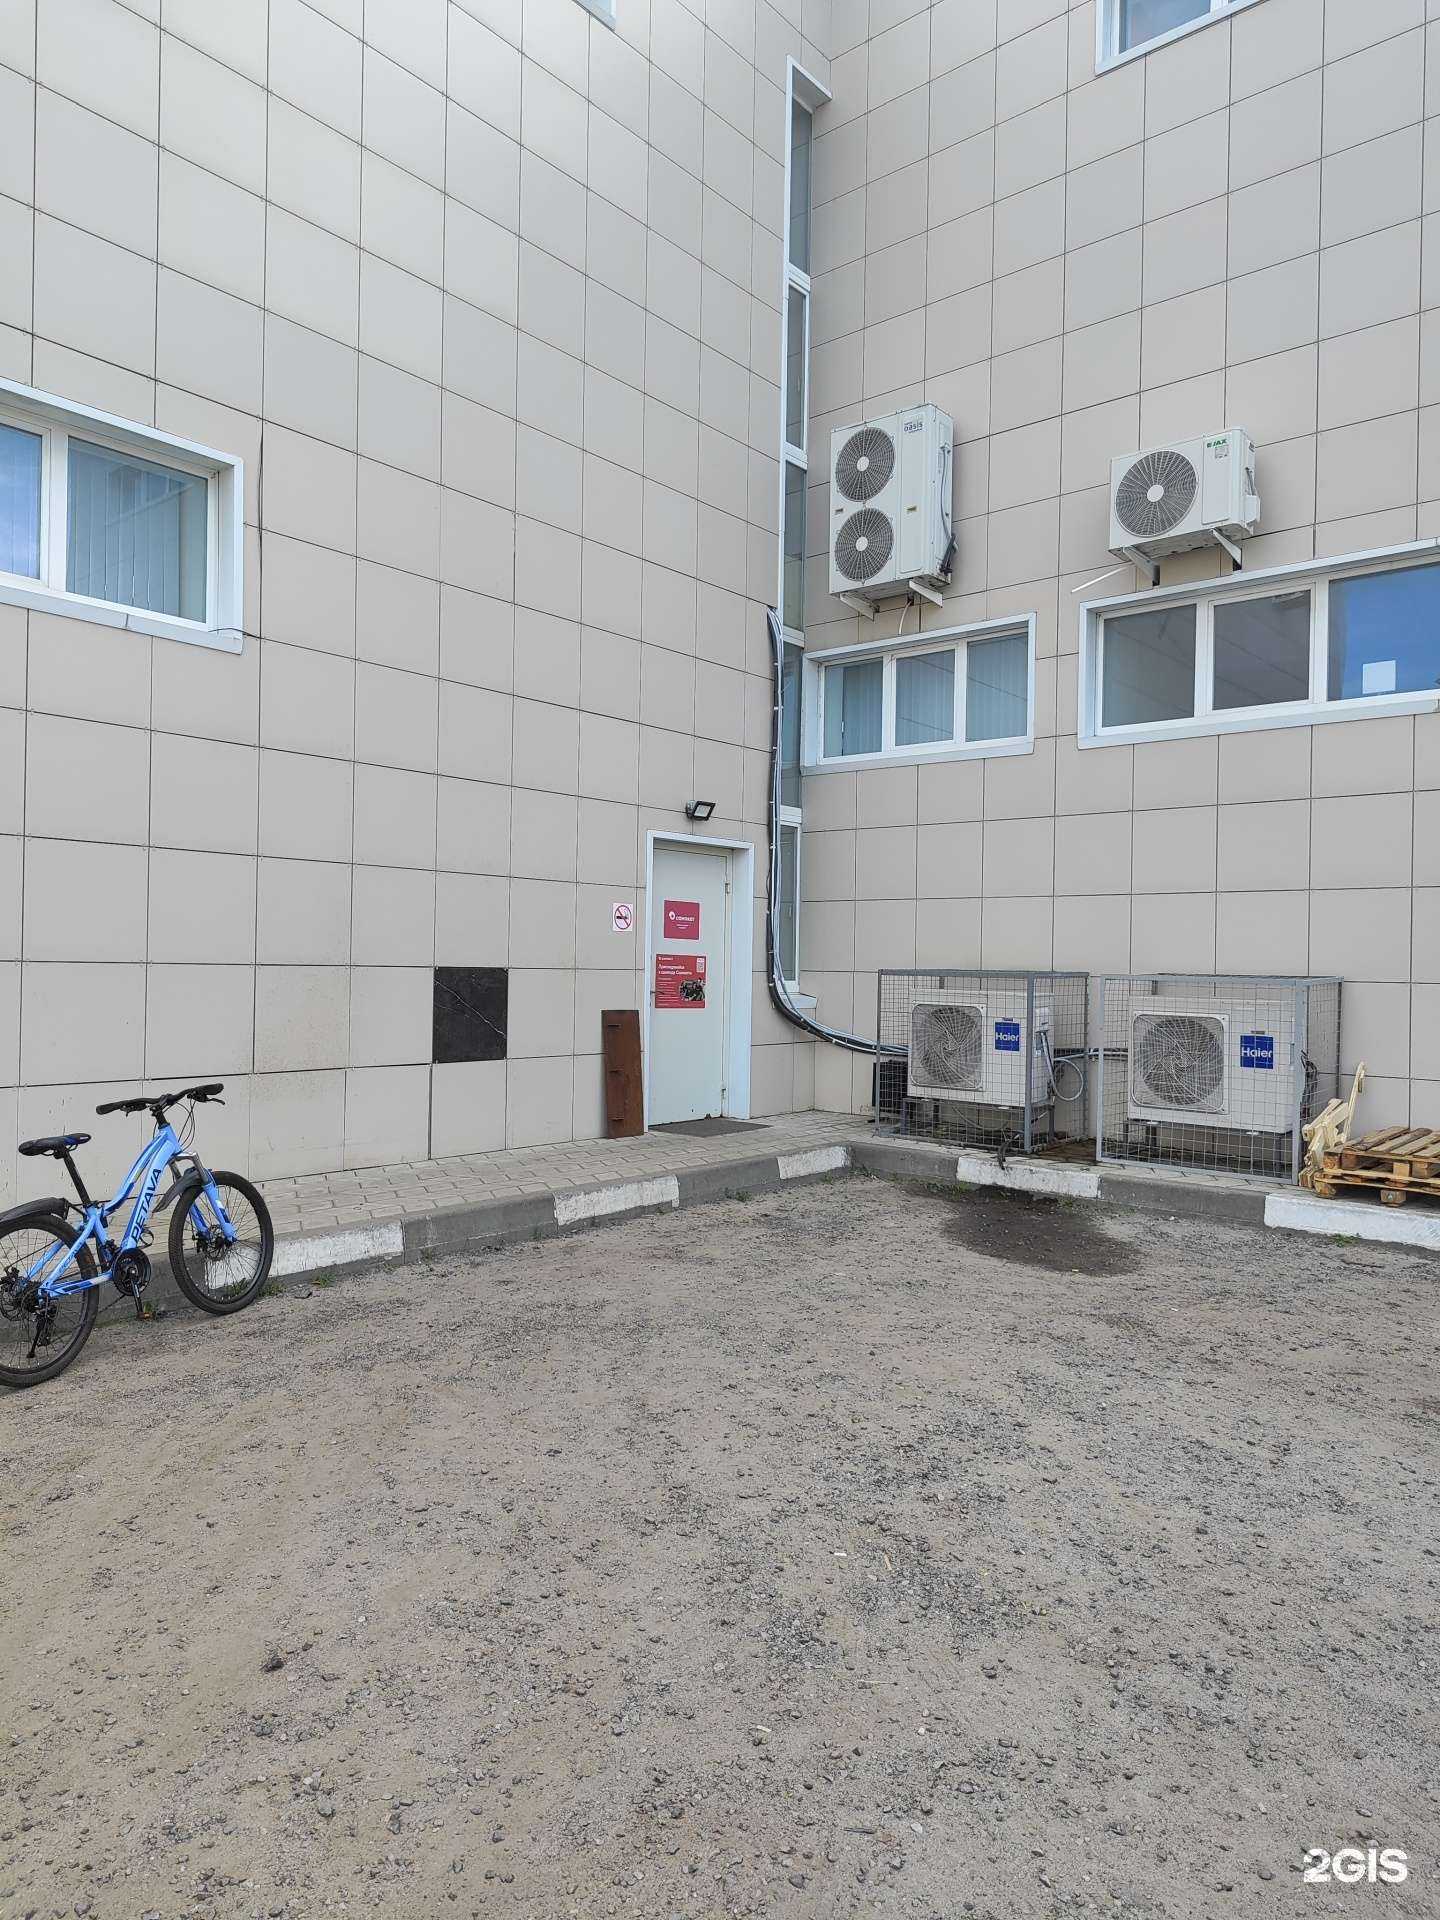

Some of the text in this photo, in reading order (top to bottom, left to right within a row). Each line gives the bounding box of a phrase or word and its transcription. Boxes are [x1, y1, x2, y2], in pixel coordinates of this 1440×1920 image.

[904, 422, 923, 431] oasis
[995, 1032, 1019, 1041] Haier
[1241, 1047, 1272, 1058] Haier
